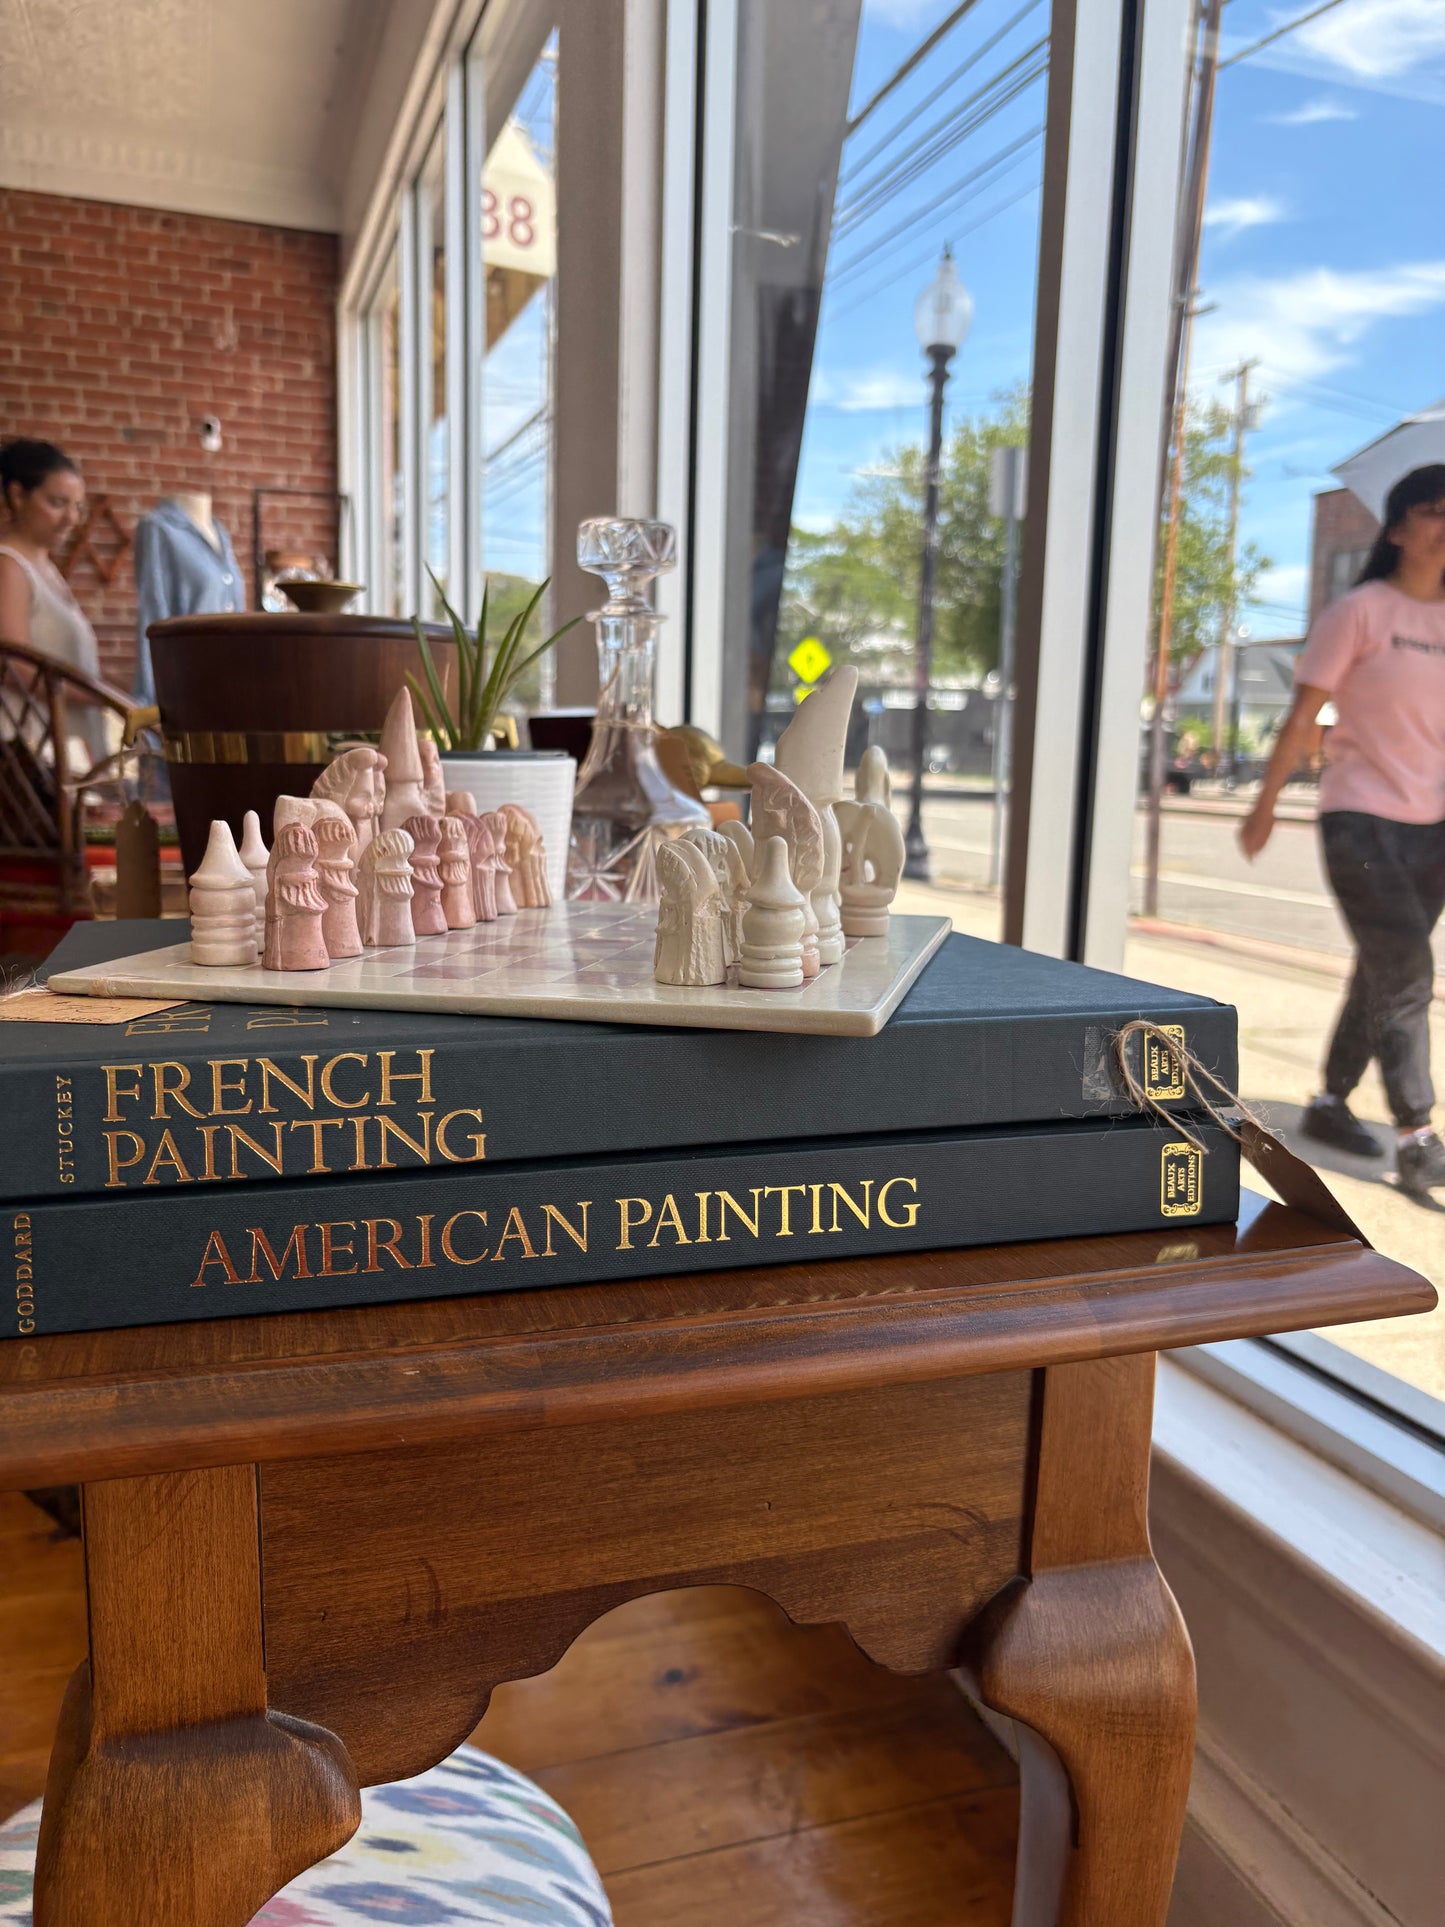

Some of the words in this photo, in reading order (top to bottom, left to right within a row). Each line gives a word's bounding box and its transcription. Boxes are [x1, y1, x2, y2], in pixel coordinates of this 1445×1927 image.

[101, 1049, 436, 1122] FRENCH
[1151, 1045, 1159, 1081] BEAUX
[1161, 1050, 1169, 1075] ARTS
[57, 1075, 75, 1183] STUCKEY
[102, 1108, 487, 1187] PAINTING
[1167, 1162, 1176, 1199] BEAUX
[1177, 1167, 1185, 1192] ARTS
[1187, 1154, 1195, 1202] EDITIONS
[190, 1201, 593, 1287] AMERICAN
[615, 1177, 922, 1250] PAINTING
[14, 1212, 36, 1334] GODDARD
